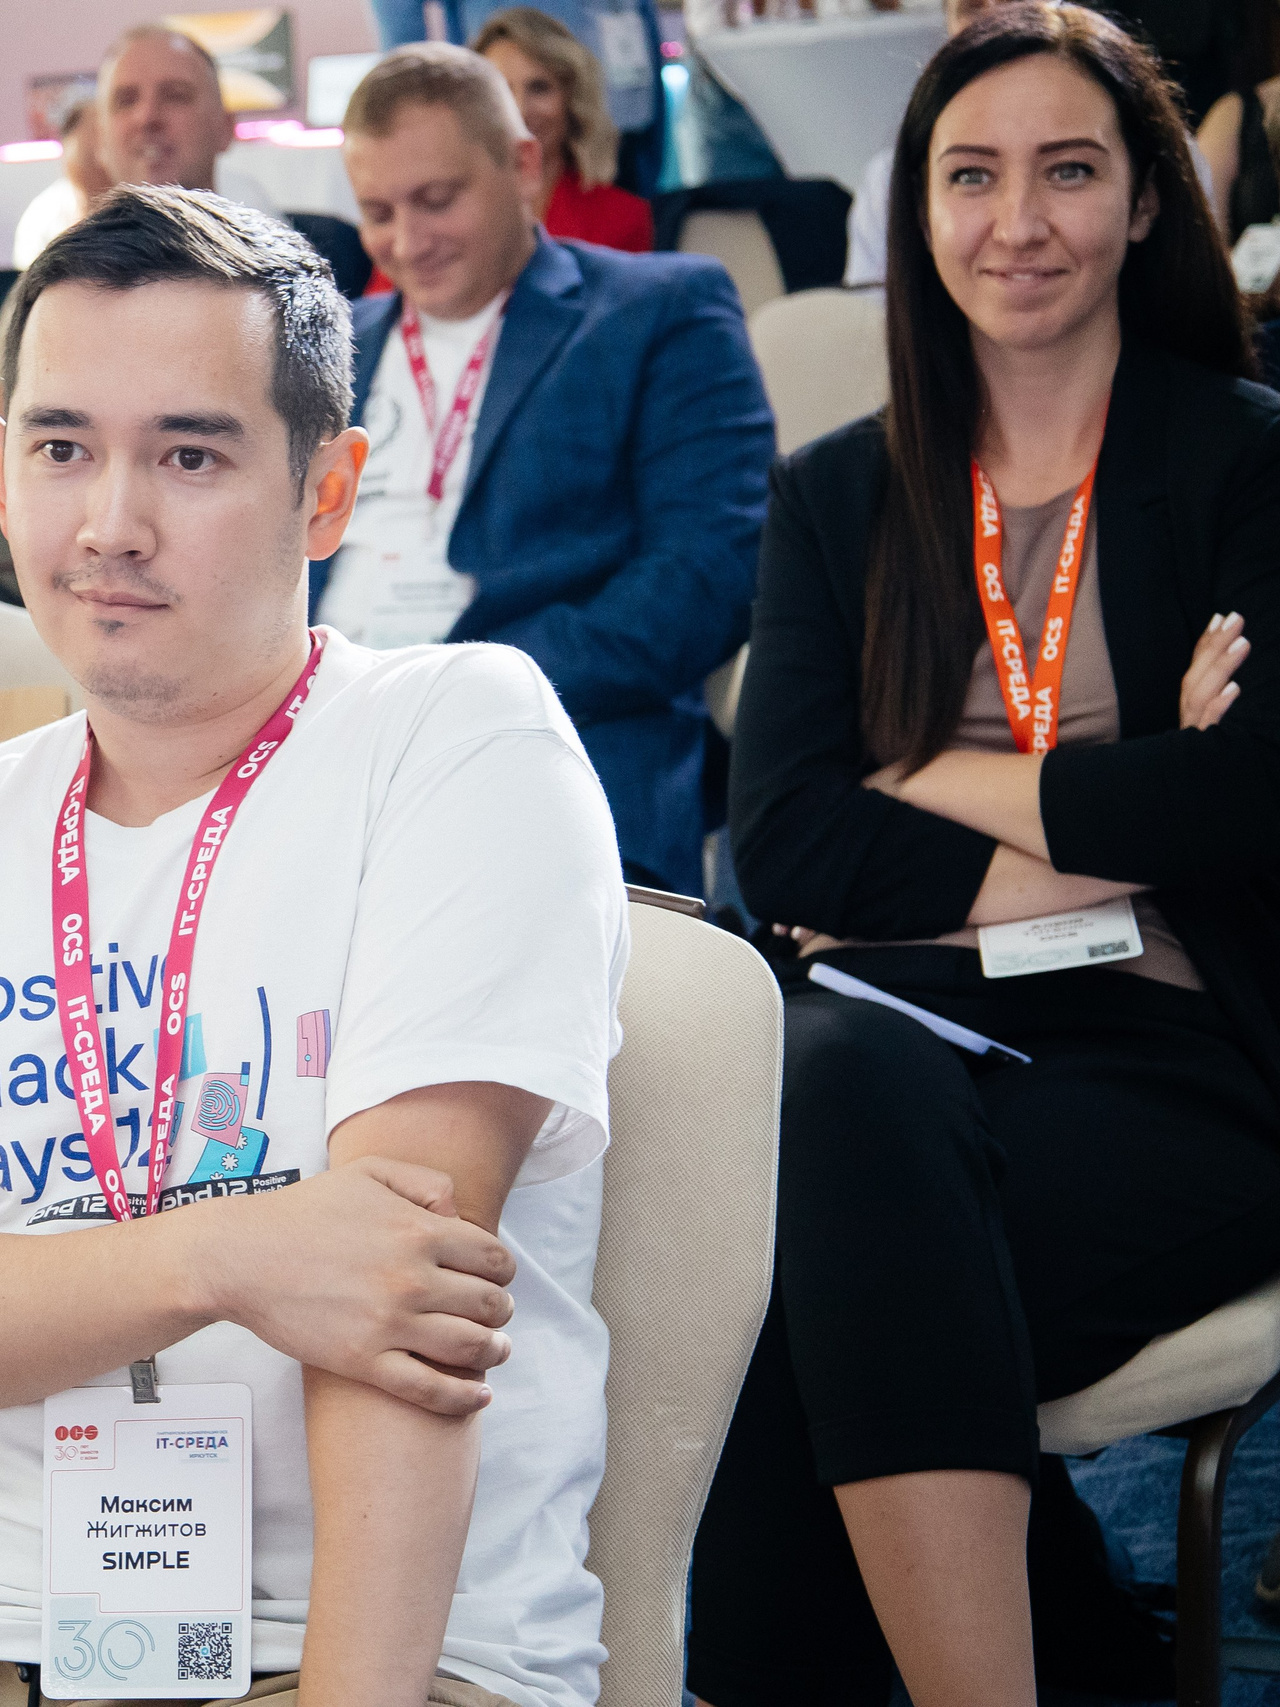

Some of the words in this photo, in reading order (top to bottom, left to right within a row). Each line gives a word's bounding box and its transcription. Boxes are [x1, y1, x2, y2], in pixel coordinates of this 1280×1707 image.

[1055, 494, 1086, 594] IT-СРЕДА
[983, 562, 1005, 602] OCS
[996, 619, 1031, 720] IT-СРЕДА
[1042, 616, 1064, 662] OCS
[1032, 686, 1053, 755] РЕДА
[57, 775, 86, 886] IT-СРЕДА
[167, 972, 186, 1036] OCS
[178, 806, 233, 936] IT-СРЕДА
[237, 741, 278, 779] OCS
[62, 913, 83, 966] OCS
[67, 995, 106, 1136] IT-СРЕДА
[79, 1195, 107, 1214] 12
[253, 1175, 287, 1187] Positive
[54, 1445, 79, 1461] 30
[156, 1435, 229, 1450] IT-СРЕДА
[101, 1496, 193, 1513] Максим
[87, 1521, 207, 1538] Жигжитов
[103, 1551, 190, 1570] SIMPLE
[55, 1620, 155, 1681] 30
